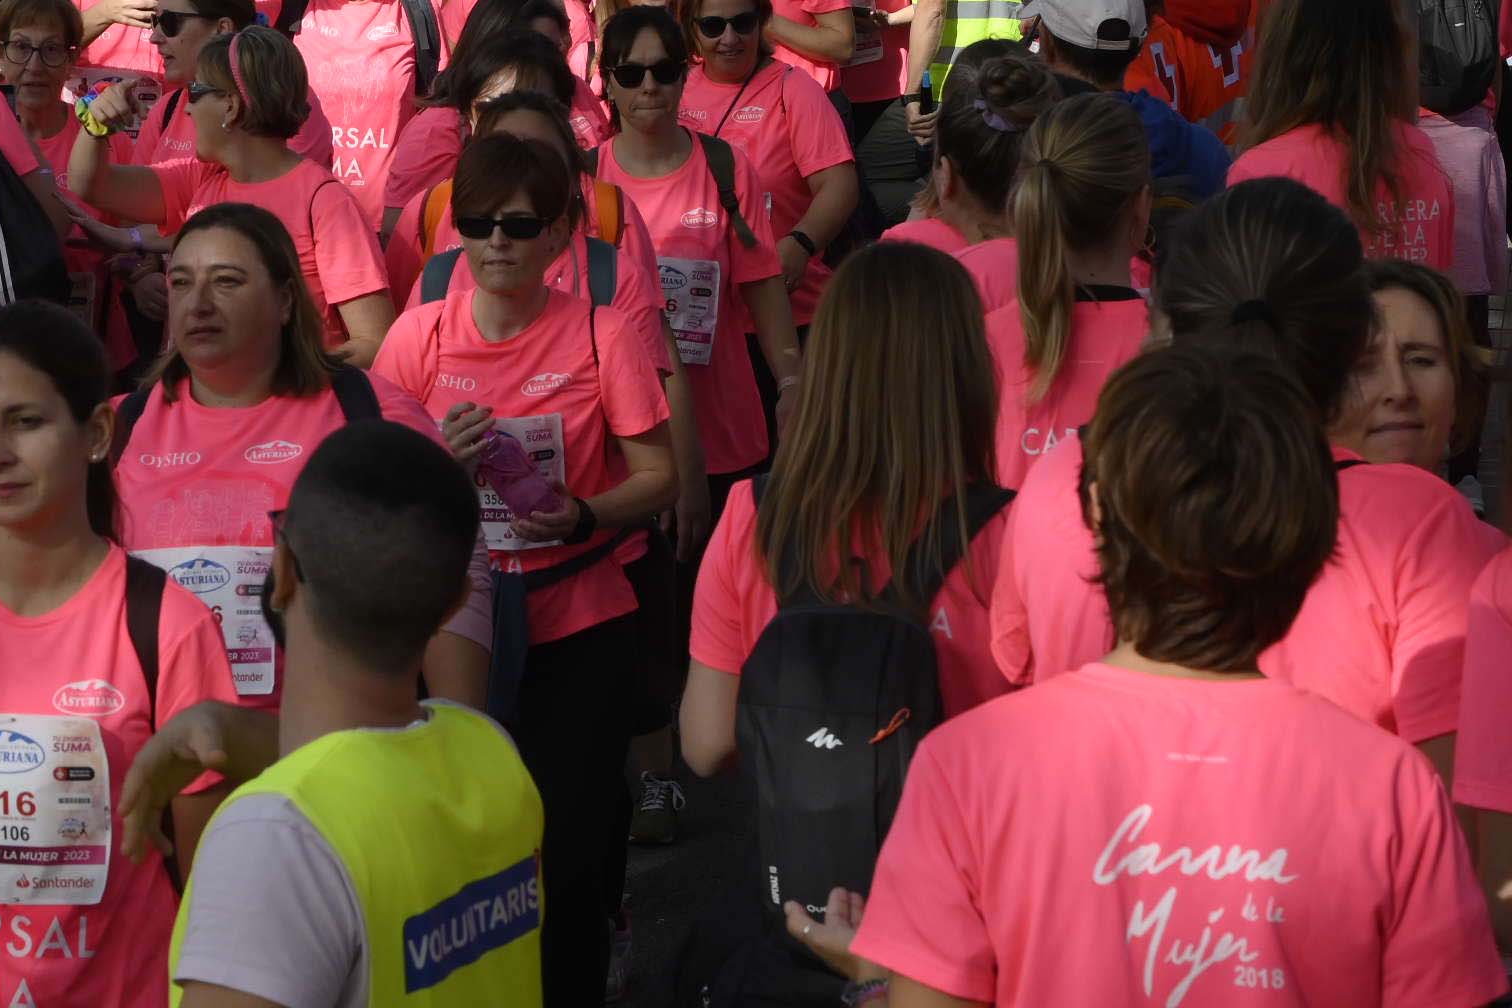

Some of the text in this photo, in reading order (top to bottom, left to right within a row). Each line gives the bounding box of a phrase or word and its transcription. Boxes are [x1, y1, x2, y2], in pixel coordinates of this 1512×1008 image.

[302, 18, 338, 36] OYHO
[526, 433, 553, 442] SUMA
[140, 452, 202, 467] OYSHO
[53, 743, 92, 753] SUMA
[3, 849, 18, 860] LA
[19, 849, 59, 861] MUJER
[63, 850, 91, 861] 2023
[31, 875, 96, 890] Santander
[407, 876, 541, 971] VOLUNTARIS
[1234, 965, 1285, 990] 2018
